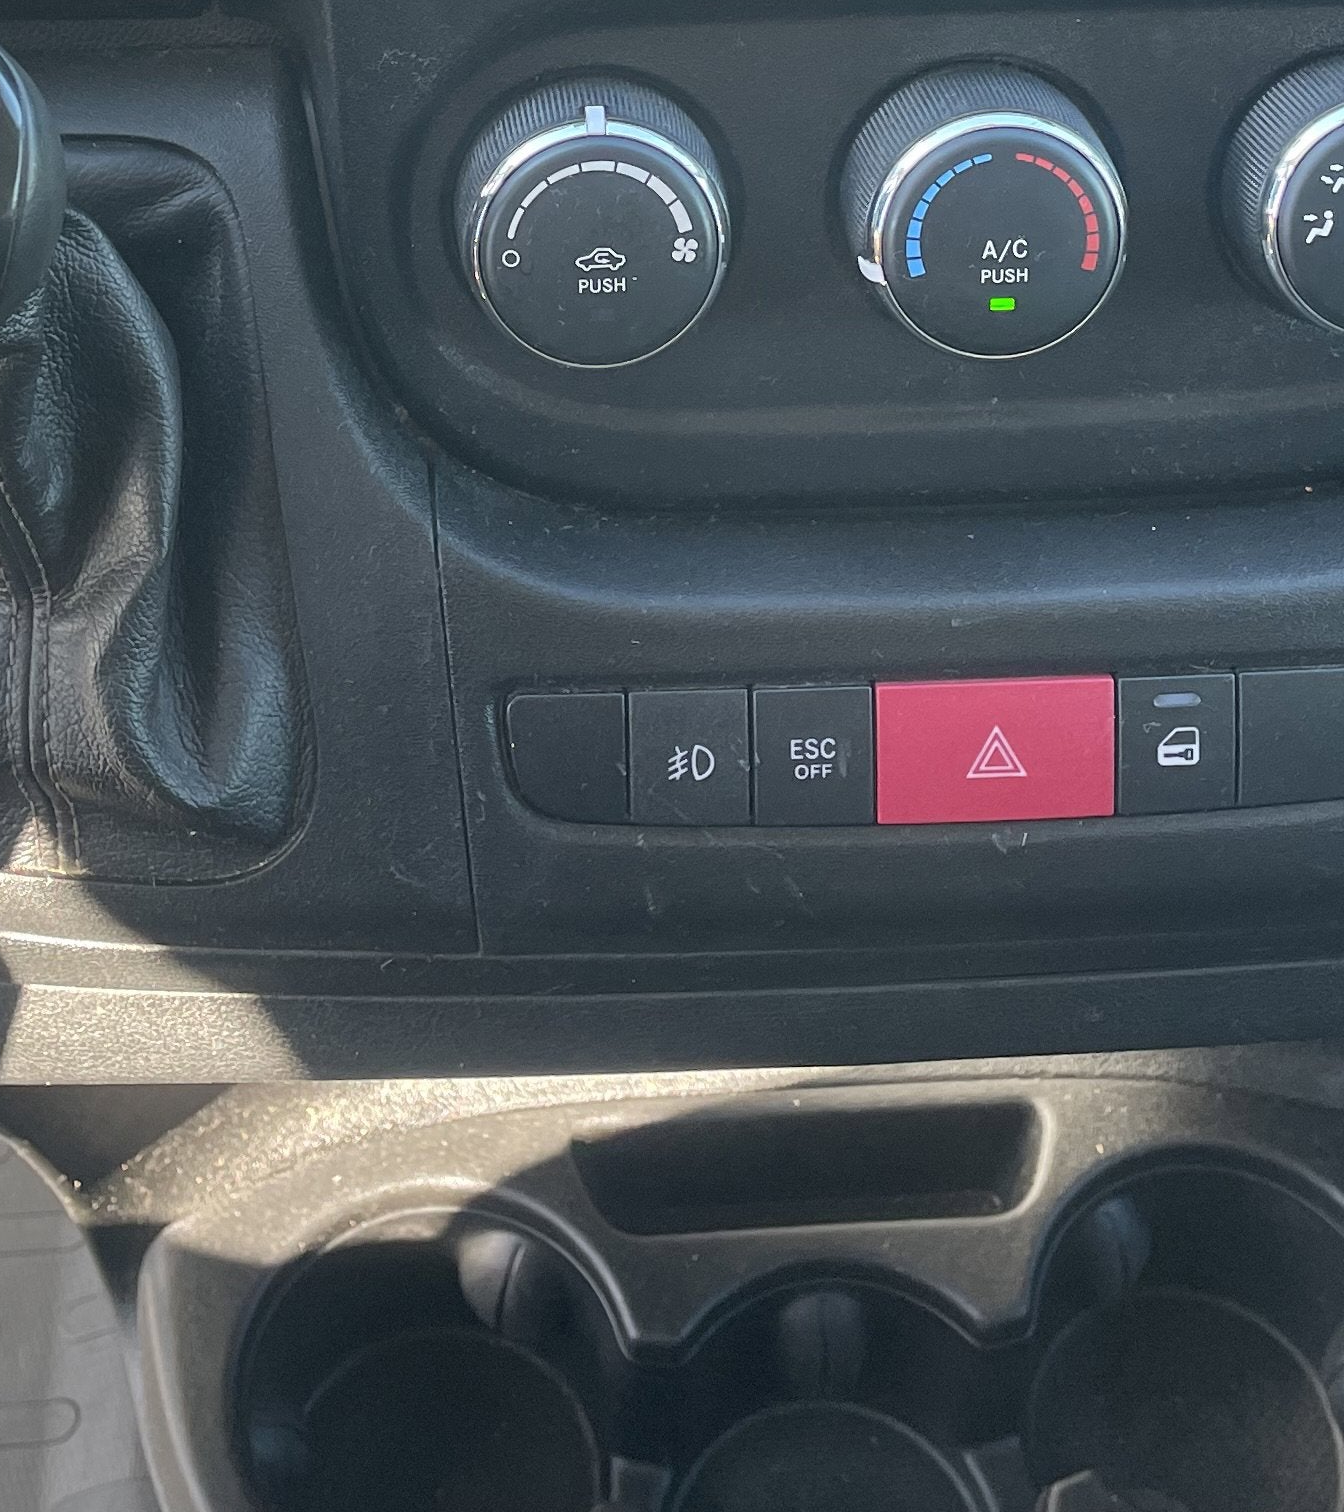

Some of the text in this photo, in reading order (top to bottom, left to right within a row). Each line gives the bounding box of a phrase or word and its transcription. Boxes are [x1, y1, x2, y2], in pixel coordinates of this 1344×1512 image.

[982, 238, 1028, 263] A/C
[980, 267, 1029, 284] PUSH
[578, 277, 626, 294] PUSH
[790, 737, 836, 760] ESC
[794, 763, 832, 780] OFF
